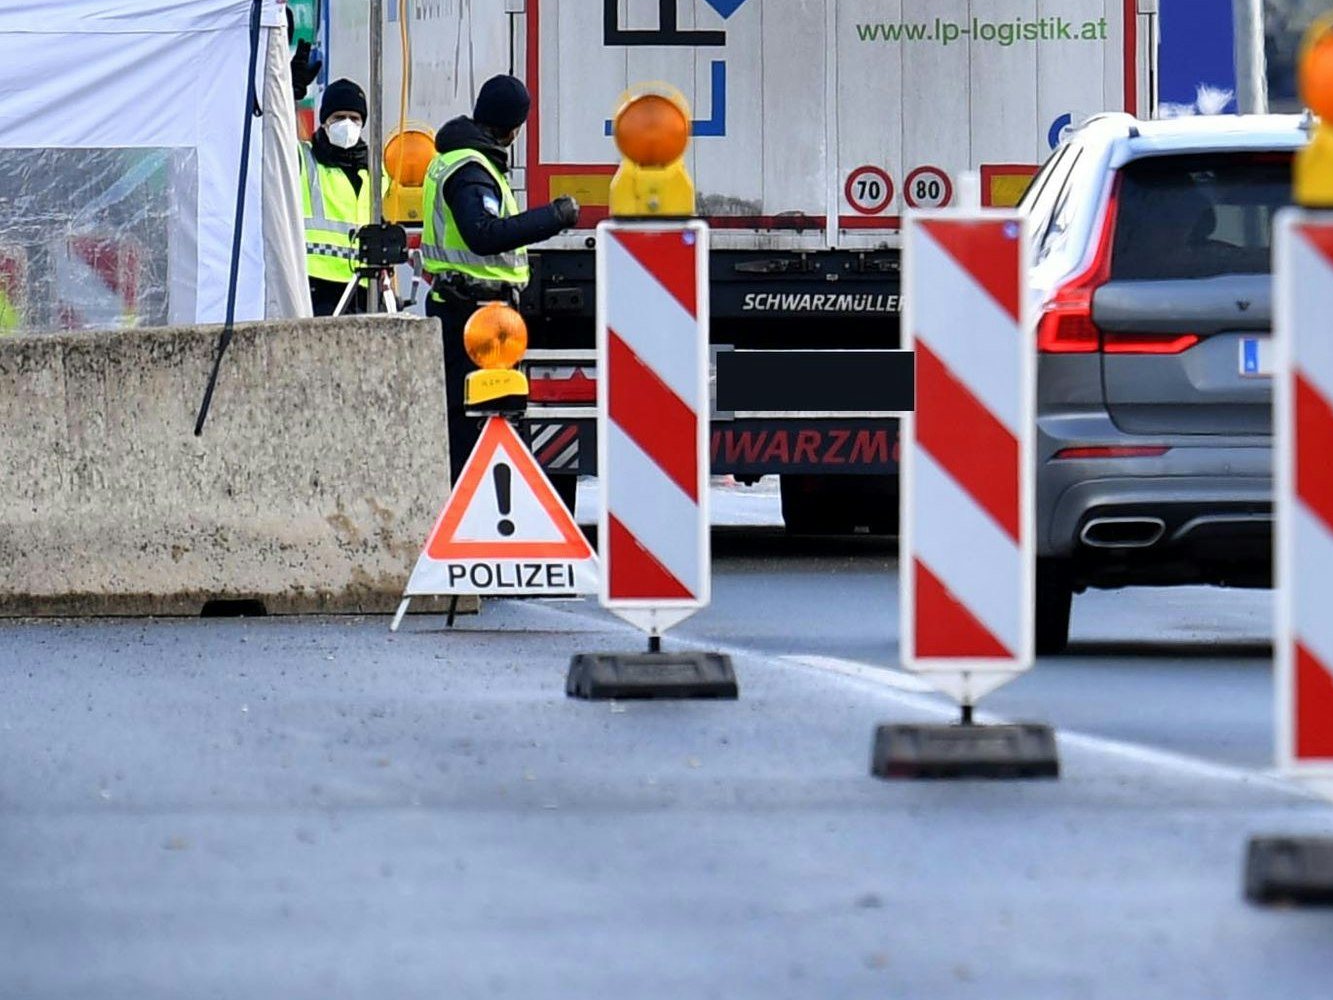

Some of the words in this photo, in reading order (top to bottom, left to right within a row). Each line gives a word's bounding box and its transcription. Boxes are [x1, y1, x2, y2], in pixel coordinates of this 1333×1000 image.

[855, 16, 1108, 46] www.lp-logistik.at
[856, 179, 881, 202] 70
[914, 179, 941, 202] 80
[447, 562, 576, 589] POLIZEI
